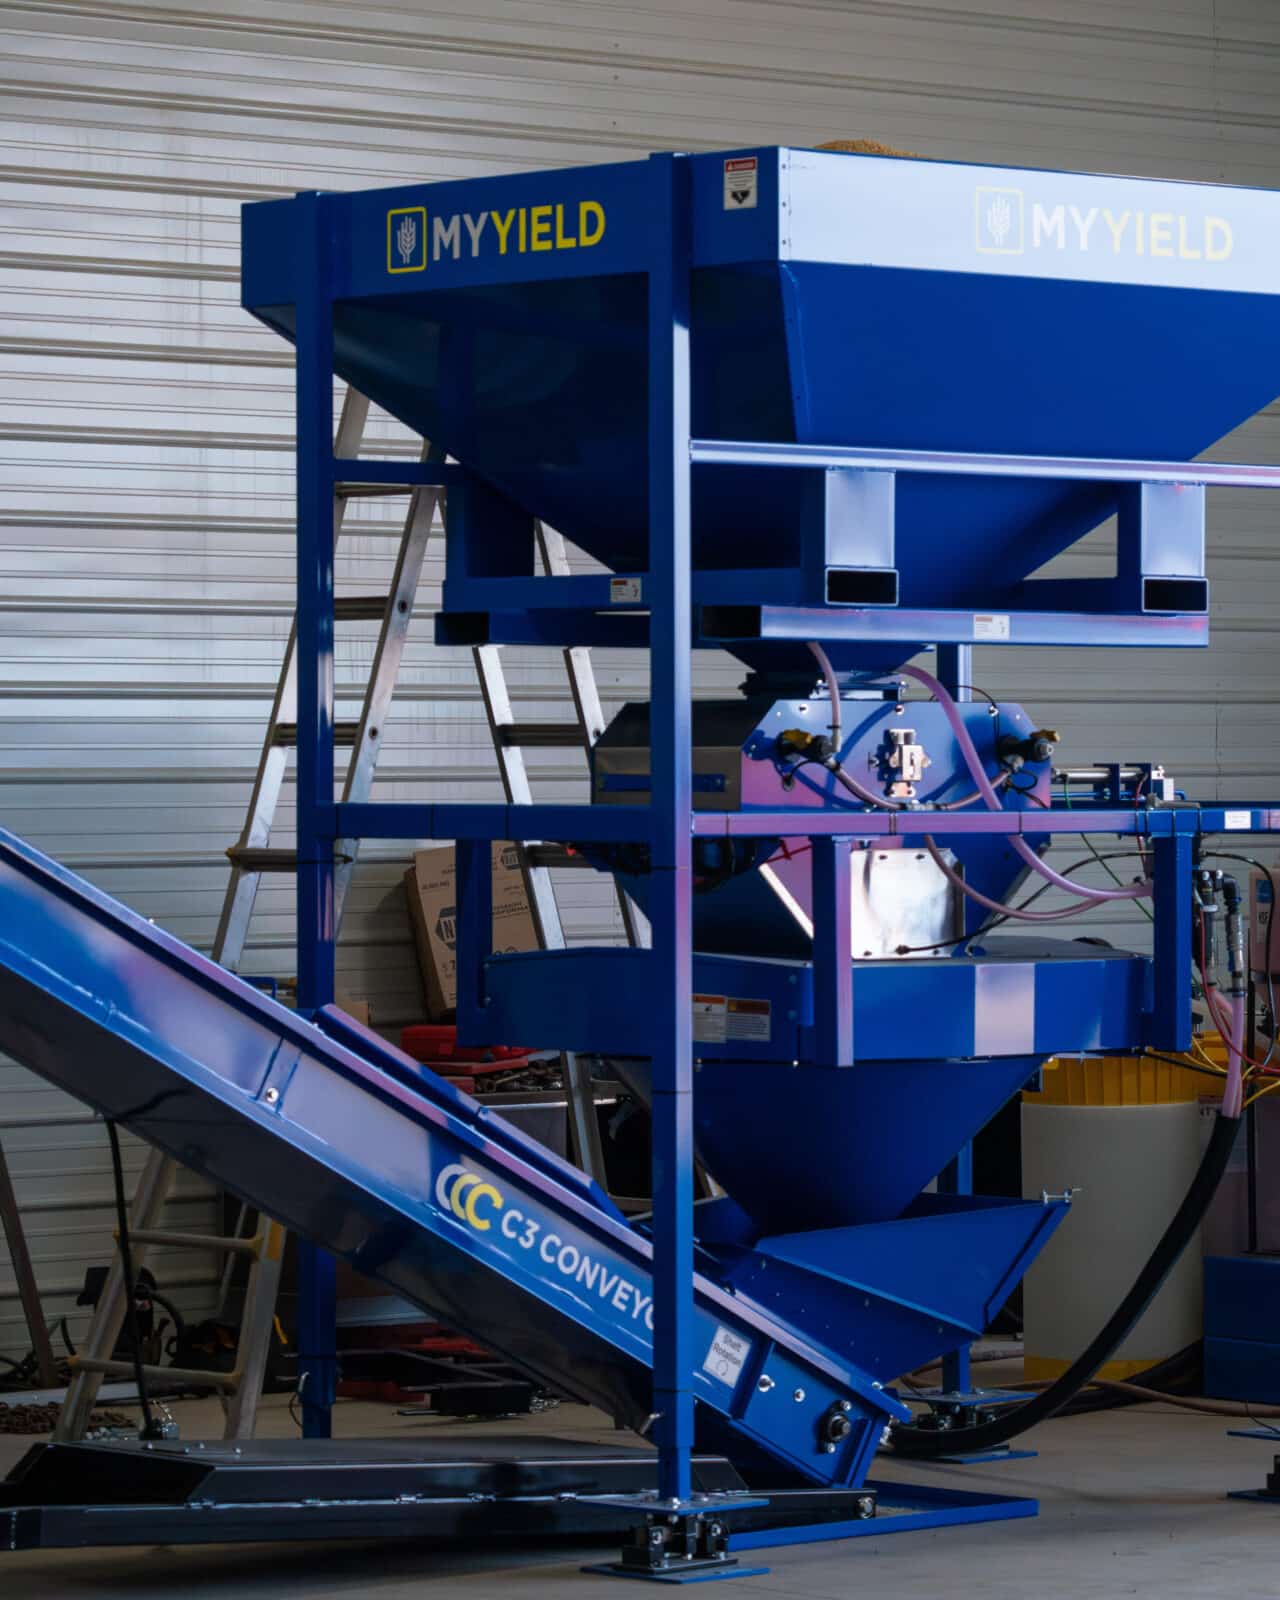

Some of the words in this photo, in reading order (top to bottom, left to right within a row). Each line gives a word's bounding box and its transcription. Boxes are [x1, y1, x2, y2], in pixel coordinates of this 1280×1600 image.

[433, 201, 606, 261] MYYIELD
[1031, 203, 1233, 261] MYYIELD
[501, 1209, 540, 1249] C3
